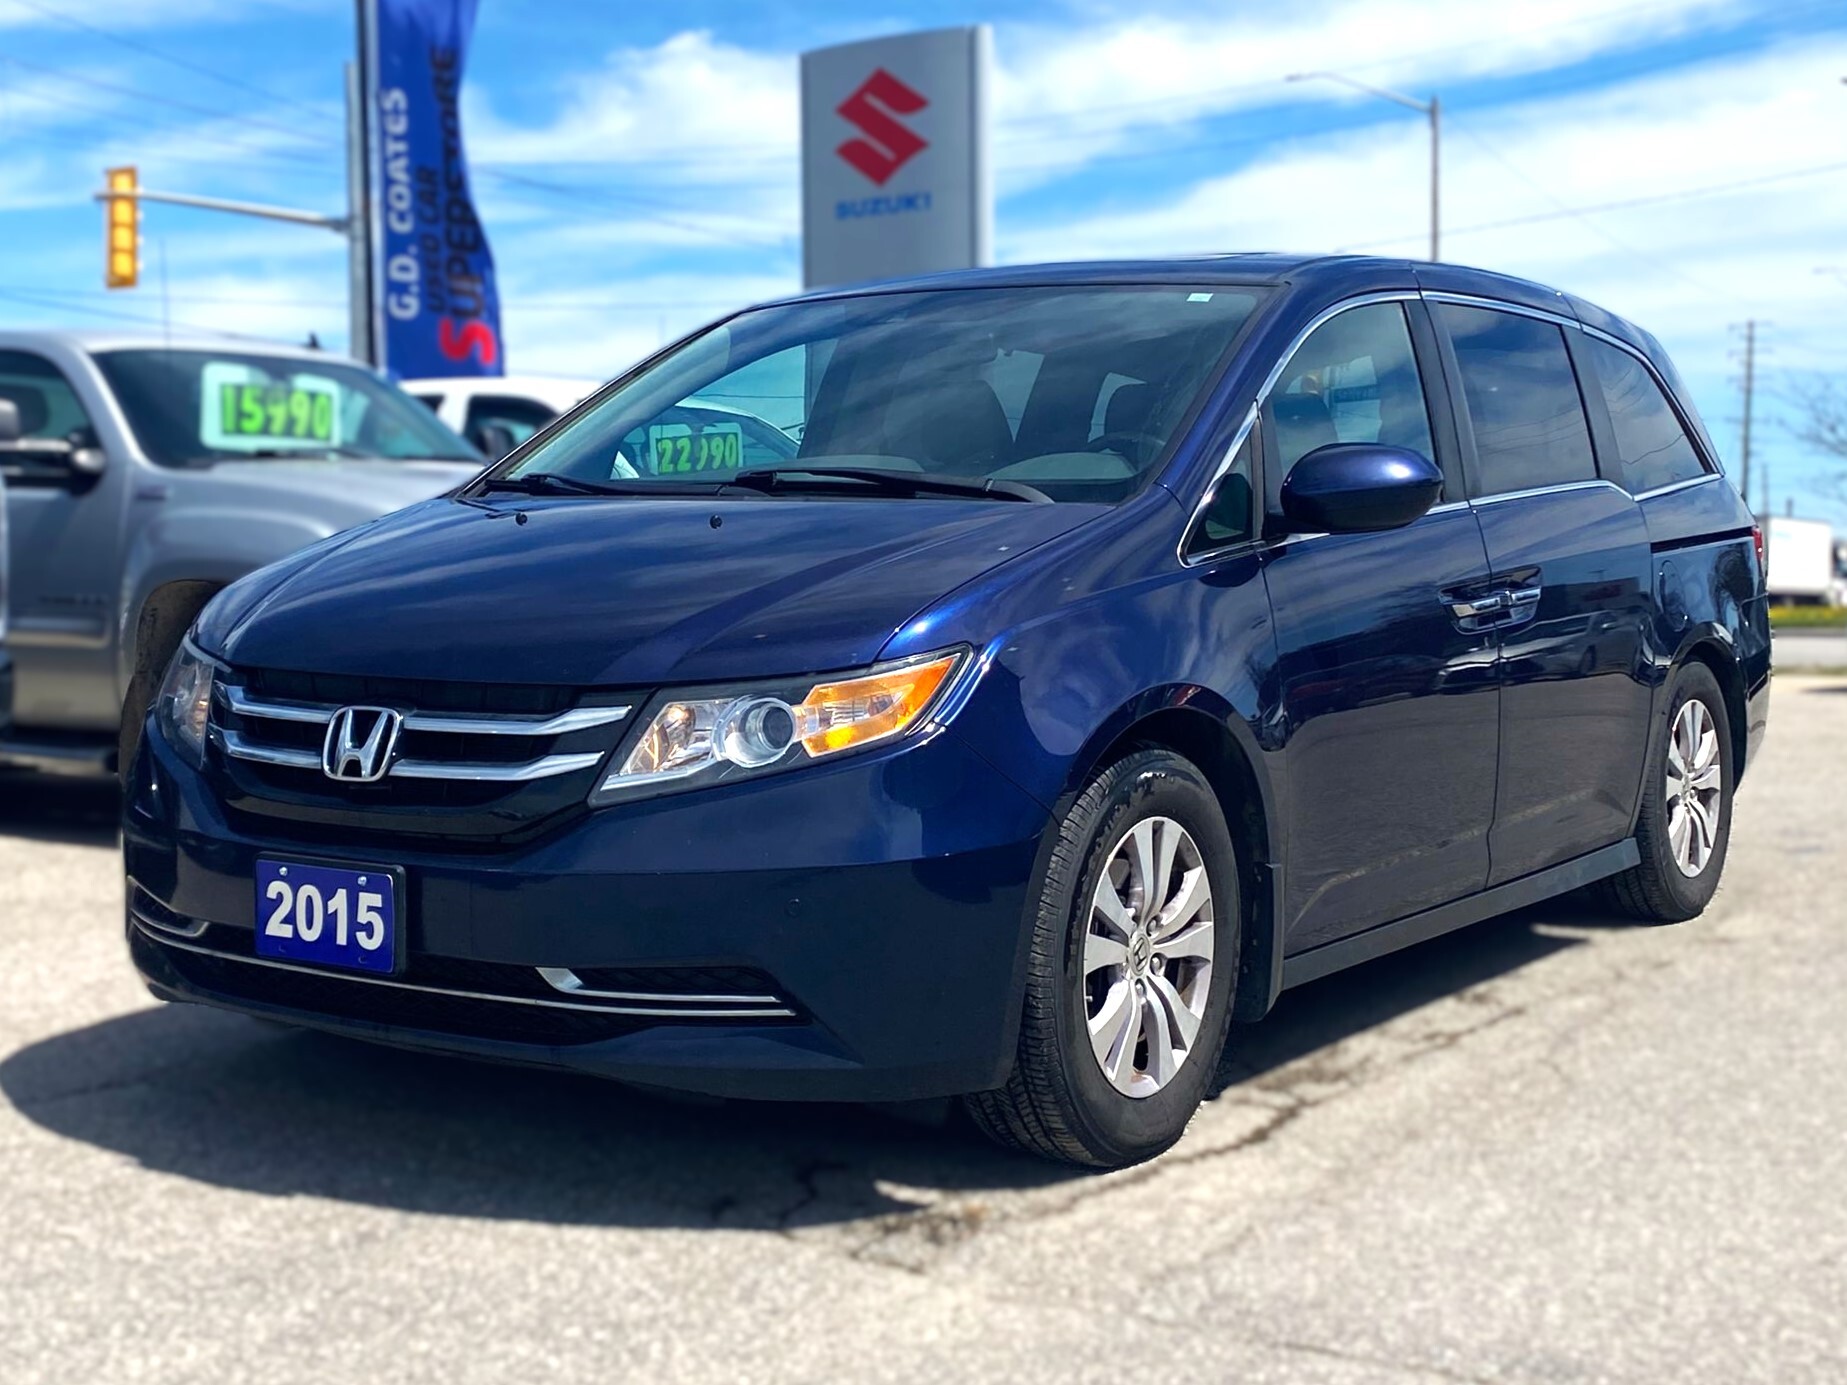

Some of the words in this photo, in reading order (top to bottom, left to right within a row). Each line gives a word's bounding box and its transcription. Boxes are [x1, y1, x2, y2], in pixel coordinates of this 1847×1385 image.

[381, 87, 415, 235] COATES
[415, 164, 441, 226] CAR
[834, 192, 932, 220] SUZUKI
[387, 245, 421, 320] G.D.
[418, 233, 446, 314] USED
[265, 880, 385, 951] 2015
